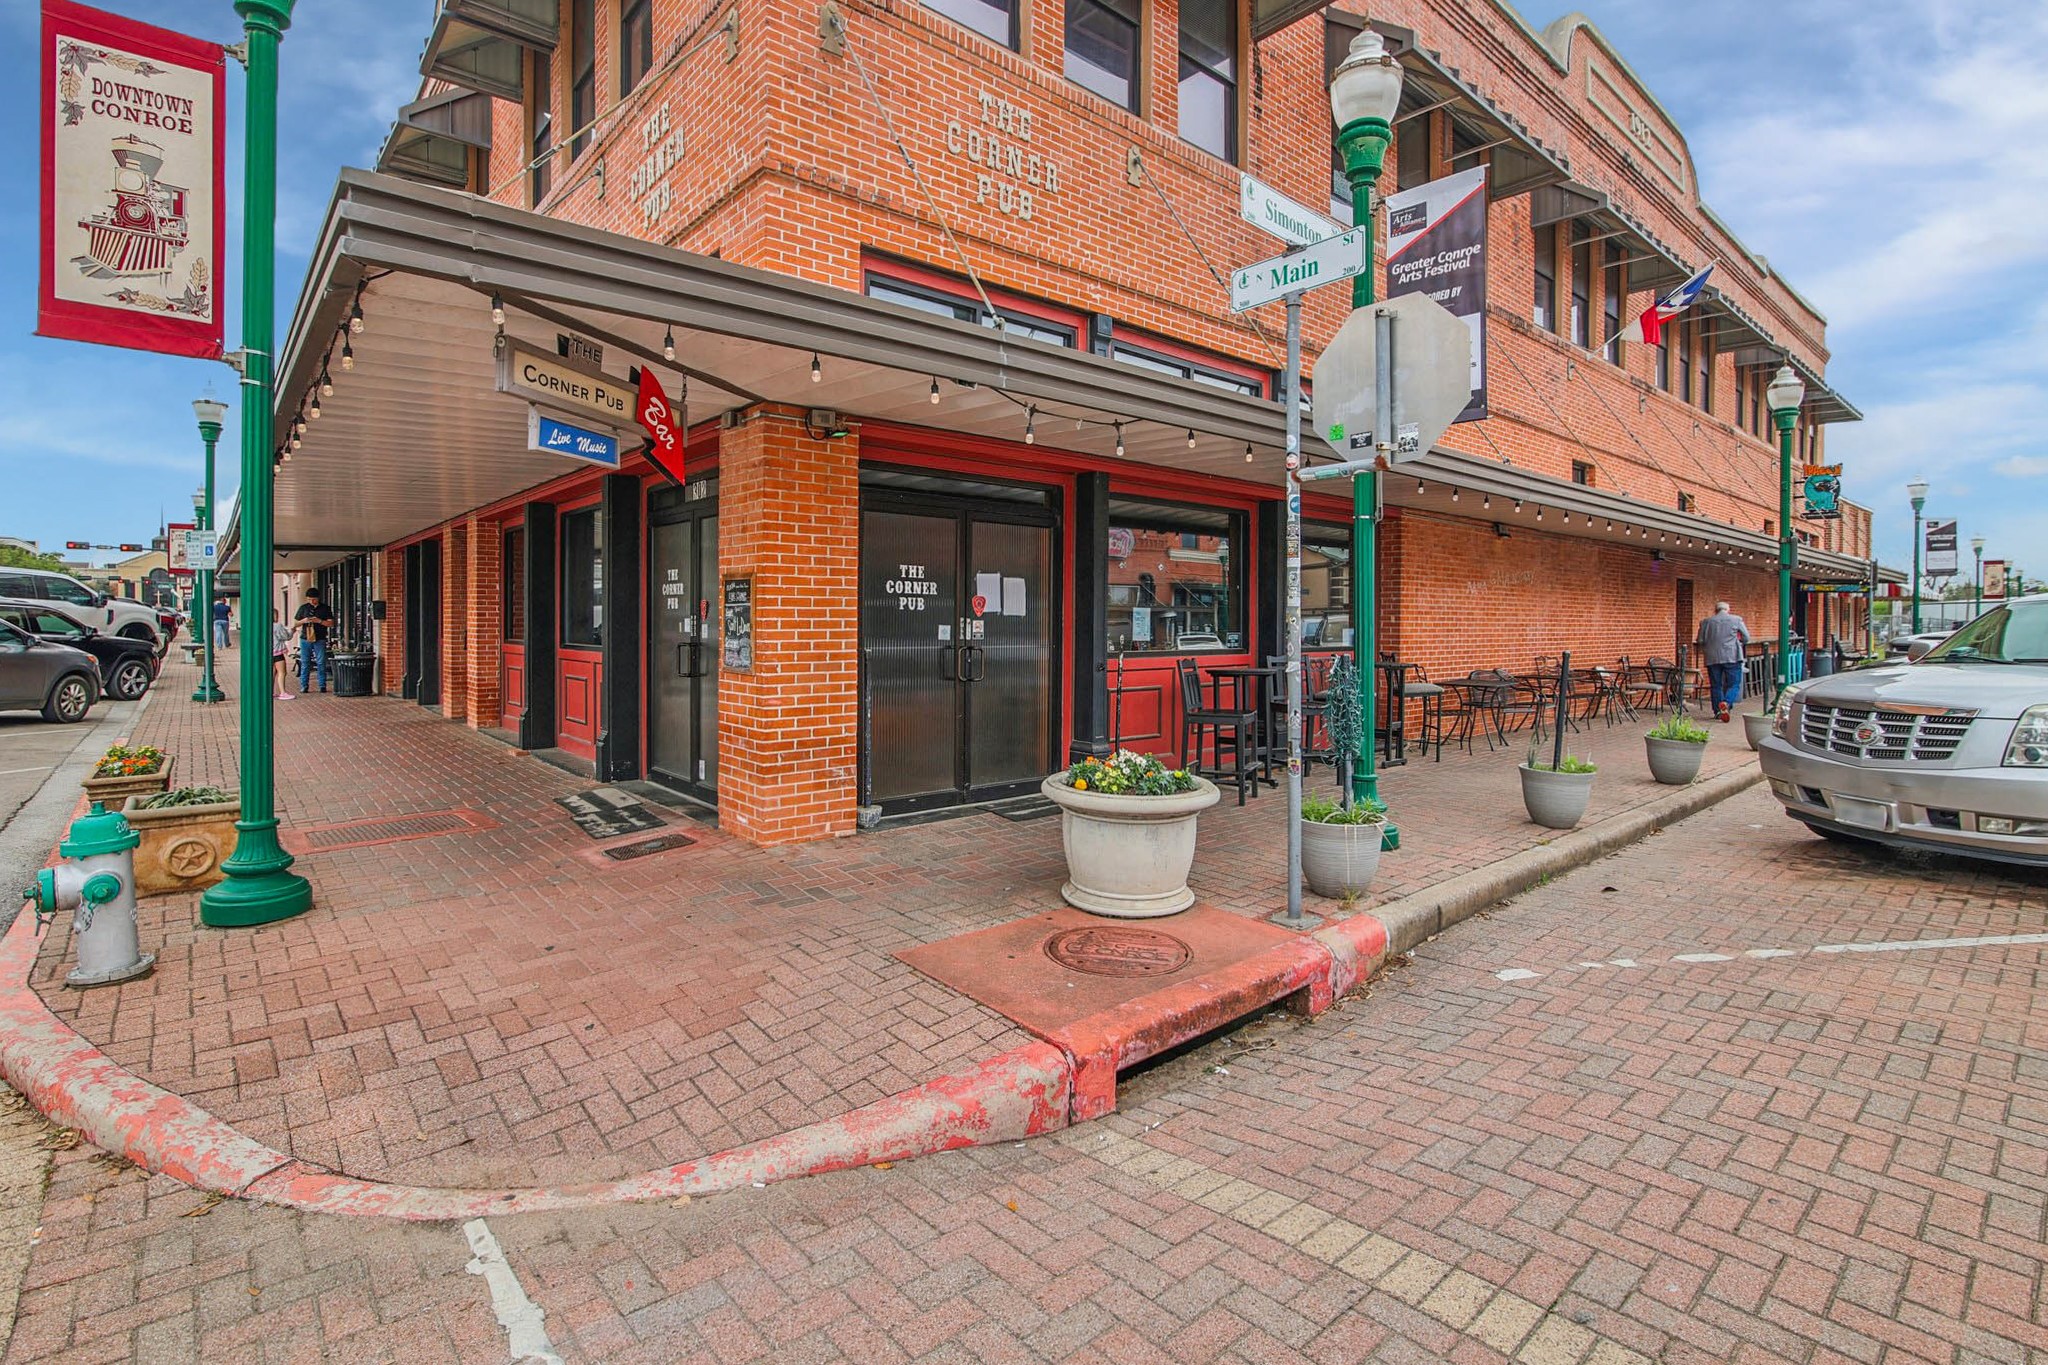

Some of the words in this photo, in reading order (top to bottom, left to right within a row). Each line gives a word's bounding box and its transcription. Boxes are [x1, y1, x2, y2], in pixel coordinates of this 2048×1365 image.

[92, 77, 193, 116] DOWNTOWN
[91, 99, 192, 134] CONROE
[642, 100, 670, 153] THE
[978, 90, 1031, 142] THE
[630, 126, 685, 203] CORNER
[947, 120, 1058, 194] CORNER
[643, 179, 671, 231] PUB
[976, 173, 1032, 220] PUB
[1265, 198, 1322, 243] Simonton
[1392, 213, 1413, 225] Arts
[1270, 258, 1319, 289] Main
[1342, 232, 1354, 246] St
[1392, 256, 1436, 275] Greater
[1437, 244, 1481, 263] Conroe
[1398, 271, 1422, 284] Arts
[1424, 254, 1470, 278] Festival
[1451, 285, 1462, 298] BY
[571, 337, 601, 364] THE
[644, 396, 675, 450] Bar
[547, 428, 571, 445] Live
[576, 437, 607, 454] Music
[667, 568, 679, 581] THE
[900, 564, 925, 579] THE
[662, 583, 684, 596] CORNER
[886, 580, 938, 595] CORNER
[667, 597, 679, 610] PUB
[899, 597, 925, 611] PUB
